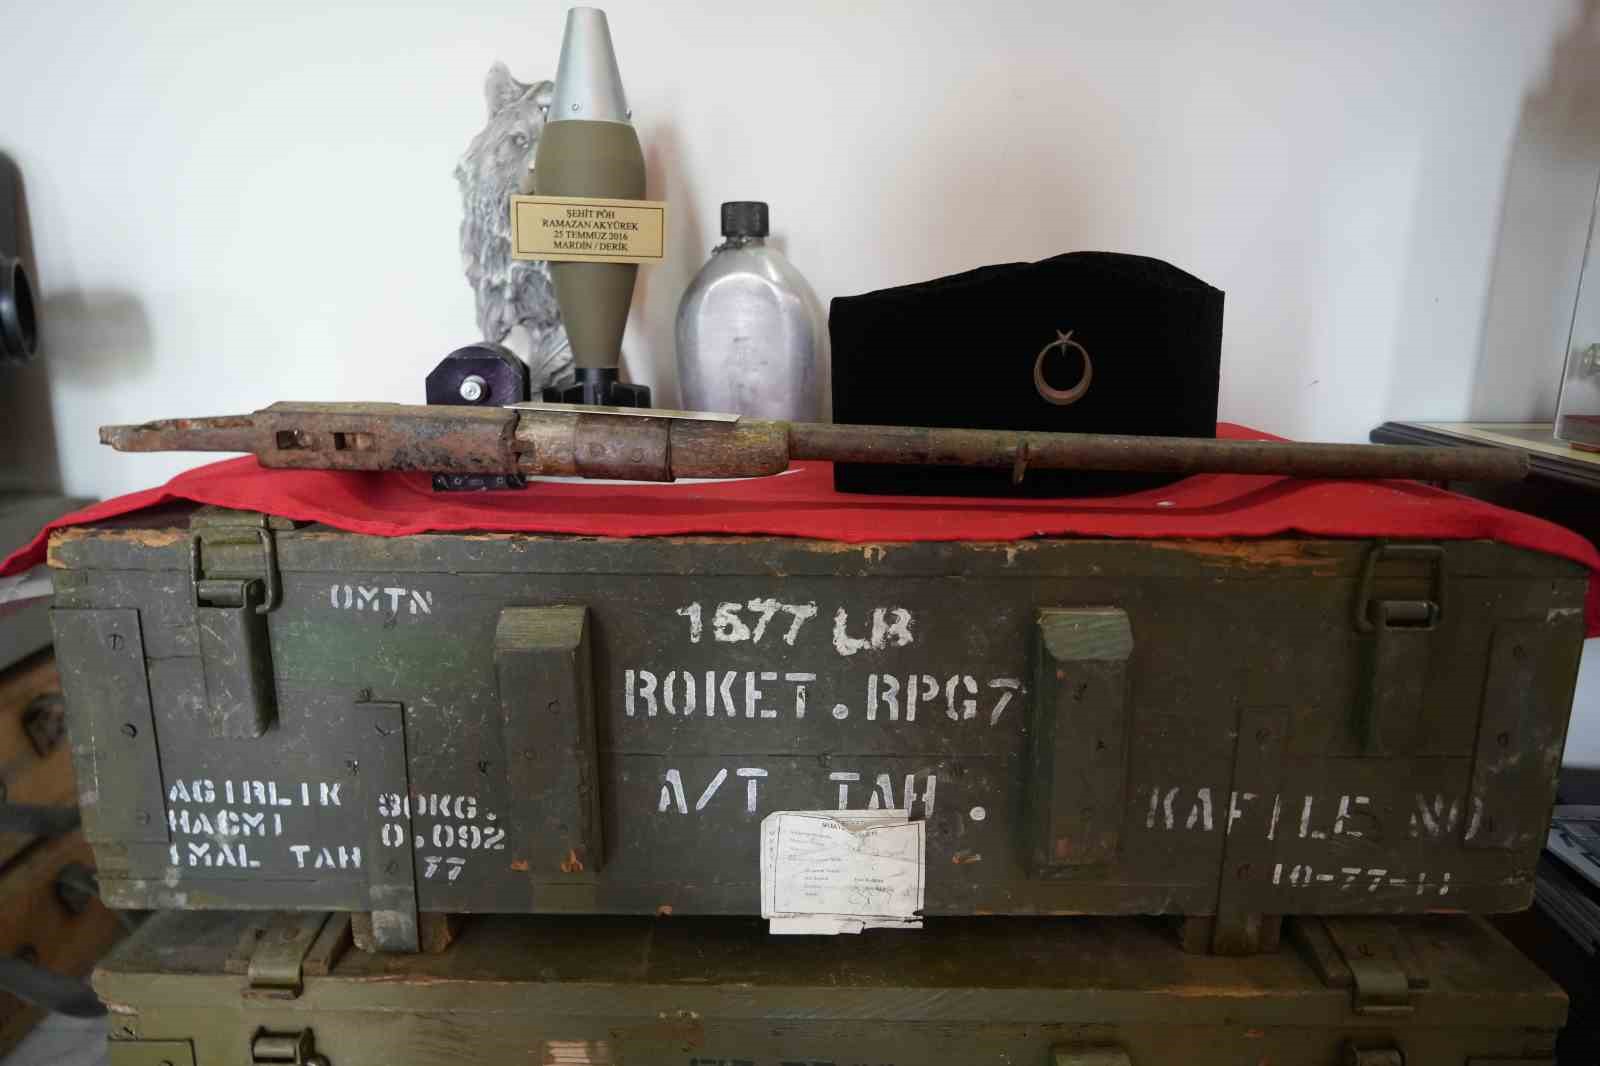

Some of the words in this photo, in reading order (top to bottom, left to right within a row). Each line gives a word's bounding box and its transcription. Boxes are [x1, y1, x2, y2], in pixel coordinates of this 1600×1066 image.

[566, 208, 593, 218] ŞEHİT
[542, 219, 592, 229] RAMAZAN
[593, 220, 639, 231] AKYÜREK
[566, 230, 607, 240] TEMMUZ
[608, 232, 629, 241] 2016
[553, 241, 592, 249] MARDİN
[330, 584, 433, 615] OMTN
[658, 767, 769, 814] A/T
[289, 844, 361, 869] TAH
[424, 855, 466, 881] 77
